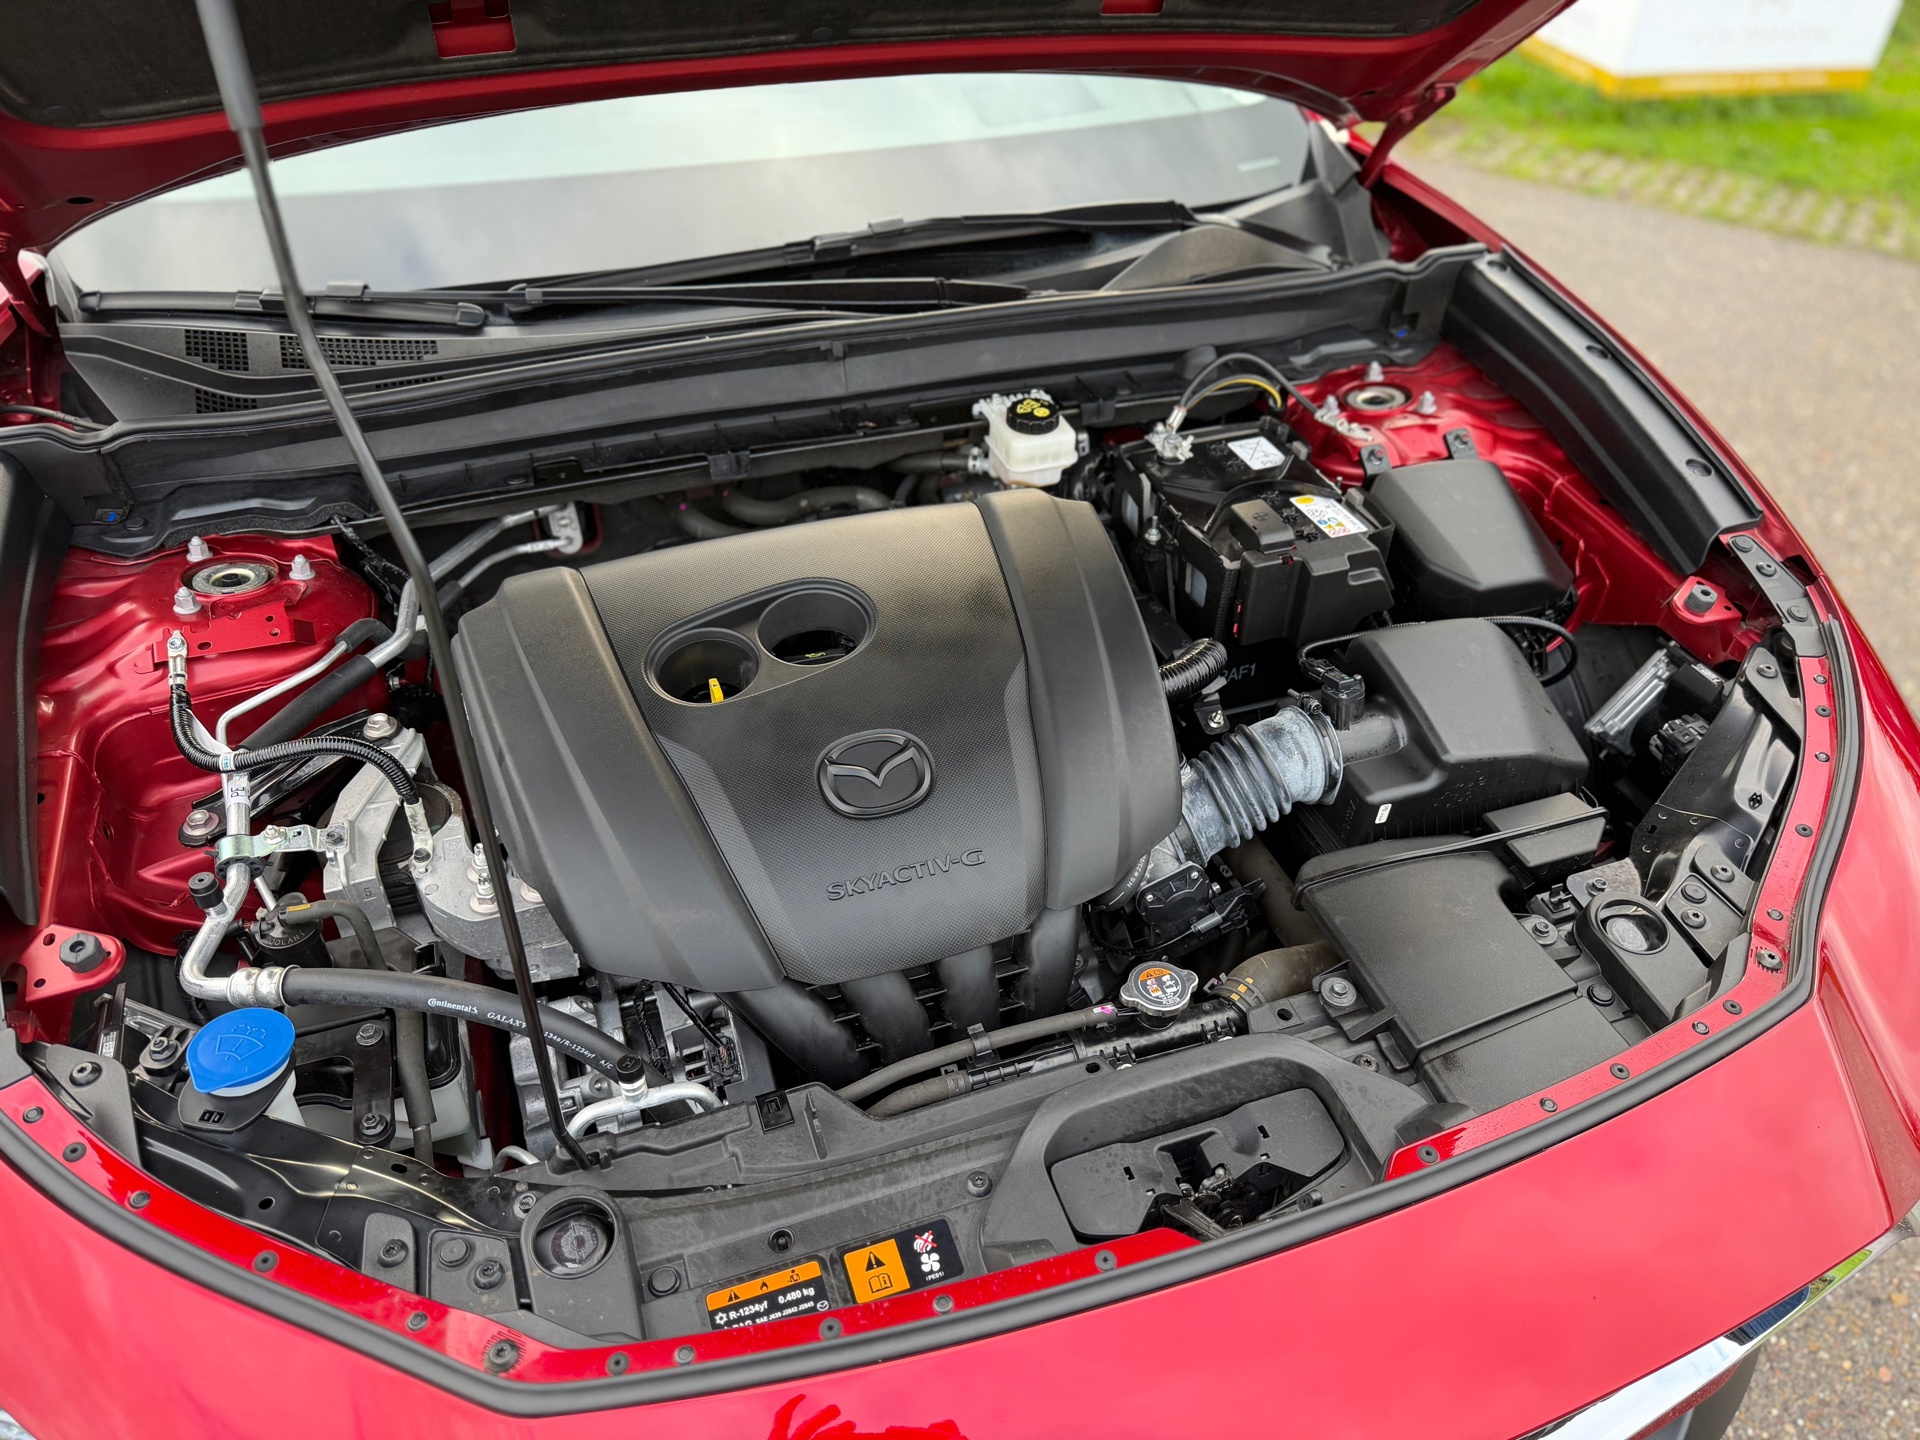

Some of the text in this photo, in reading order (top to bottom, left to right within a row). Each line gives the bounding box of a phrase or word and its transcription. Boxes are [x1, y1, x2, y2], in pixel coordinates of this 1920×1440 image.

[826, 848, 986, 901] SKYACTIV-G
[265, 930, 306, 946] OOLANT
[427, 997, 614, 1070] Continental GALAXY 134a/R-1234yf A/C
[729, 1286, 815, 1320] R-1234yf 0.480 kg
